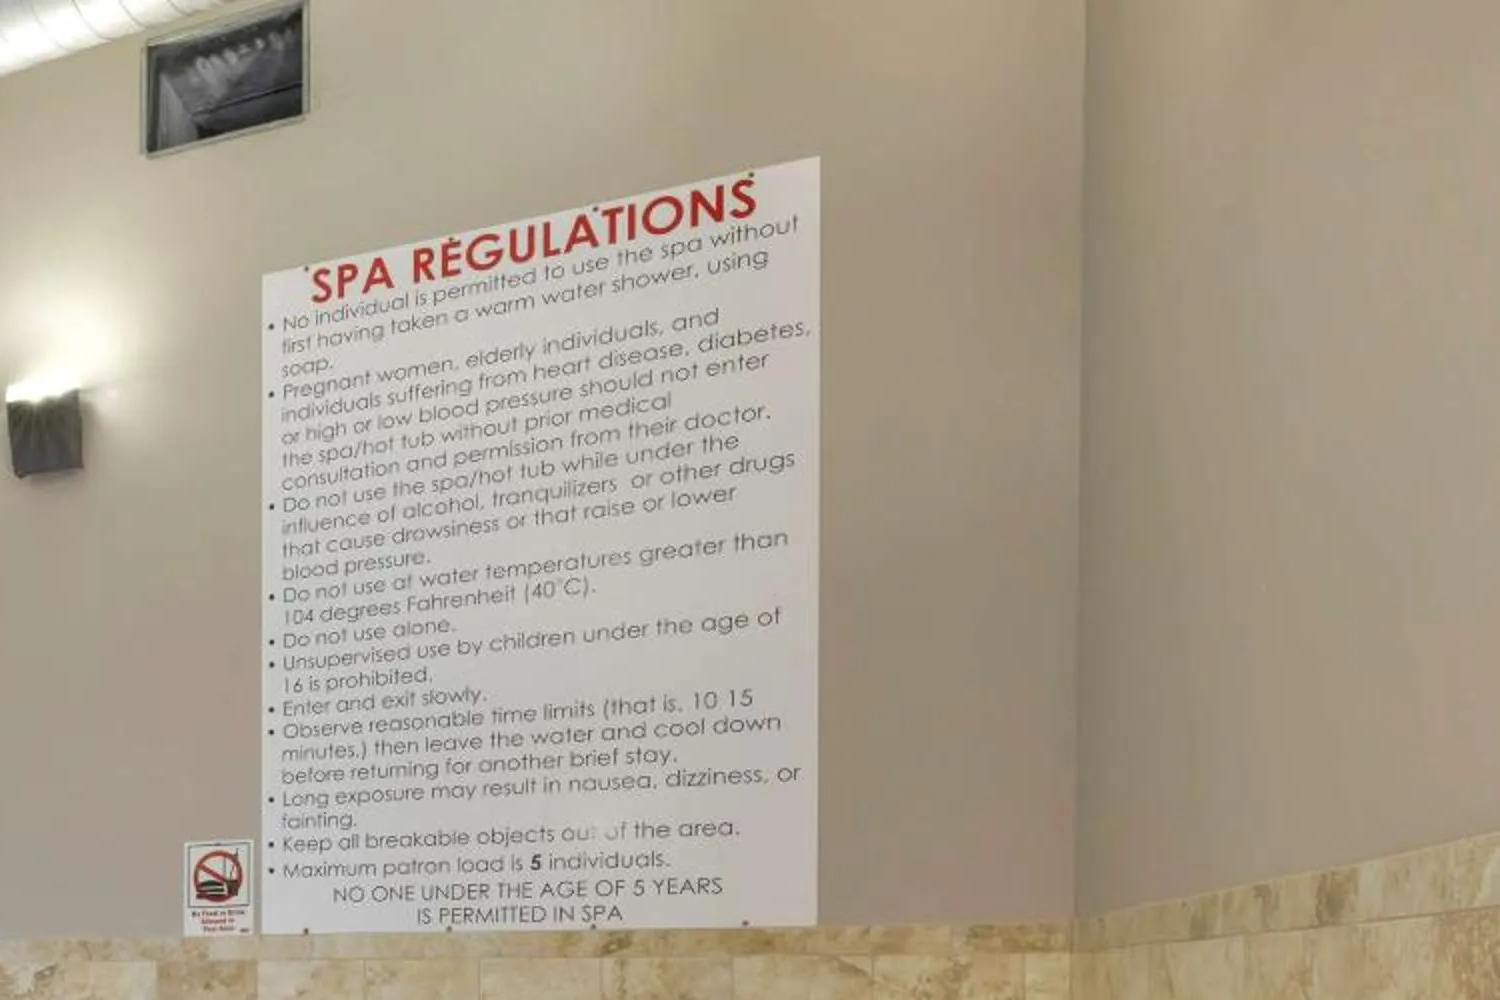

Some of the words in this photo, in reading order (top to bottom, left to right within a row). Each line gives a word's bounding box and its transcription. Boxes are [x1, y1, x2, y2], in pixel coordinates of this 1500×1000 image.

[310, 257, 395, 304] SPA
[412, 179, 757, 285] REGULATIONS
[282, 314, 311, 332] No
[313, 291, 409, 326] individual
[415, 289, 429, 307] is
[432, 267, 537, 307] permitted
[544, 263, 565, 282] to
[571, 256, 610, 276] use
[616, 246, 653, 267] the
[659, 237, 703, 261] spa
[708, 214, 798, 249] without
[316, 324, 385, 348] having
[390, 311, 448, 335] taken
[453, 308, 469, 323] a
[474, 294, 535, 318] warm
[540, 280, 607, 305] water
[707, 250, 769, 275] using
[282, 369, 371, 401] Pregnant
[465, 342, 536, 369] elderly
[671, 306, 719, 332] and
[280, 431, 300, 446] or
[305, 420, 347, 443] high
[352, 418, 373, 435] or
[377, 411, 413, 430] low
[418, 397, 482, 424] blood
[484, 386, 573, 417] pressure
[578, 368, 653, 398] should
[660, 361, 699, 384] not
[704, 353, 770, 377] enter
[281, 391, 382, 423] individuals
[386, 378, 473, 406] suffering
[478, 368, 528, 390] from
[532, 355, 591, 381] heart
[281, 460, 400, 493] consultation
[405, 449, 447, 473] and
[451, 434, 564, 470] permission
[570, 428, 621, 448] from
[628, 415, 678, 440] their
[282, 450, 314, 468] the
[317, 435, 394, 466] spa/hot
[400, 429, 435, 449] tub
[438, 415, 518, 444] without
[524, 409, 573, 436] prior
[578, 391, 671, 423] medical
[281, 511, 371, 535] influence
[376, 503, 396, 524] of
[492, 477, 617, 508] tranquilizers
[630, 472, 653, 489] or
[659, 463, 723, 485] other
[728, 452, 795, 475] drugs
[282, 496, 311, 513] Do
[315, 489, 348, 509] not
[353, 486, 387, 503] use
[392, 480, 425, 497] the
[429, 464, 513, 497] spa/hot
[519, 459, 556, 480] tub
[560, 451, 619, 473] while
[625, 440, 695, 465] under
[700, 433, 739, 455] the
[282, 538, 321, 558] that
[325, 532, 386, 553] cause
[505, 513, 528, 530] or
[532, 503, 577, 526] that
[582, 498, 636, 519] raise
[641, 495, 665, 513] or
[671, 486, 737, 508] lower
[282, 586, 311, 604] Do
[314, 580, 347, 599] not
[353, 578, 387, 596] use
[390, 573, 413, 591] at
[419, 567, 479, 587] water
[484, 550, 632, 581] temperatures
[638, 539, 726, 567] greater
[733, 532, 788, 552] than
[282, 559, 339, 581] blood
[285, 608, 315, 625] 104
[318, 600, 401, 623] degrees
[406, 583, 516, 613] Fahrenheit
[282, 632, 311, 649] Do
[314, 627, 347, 646] not
[353, 624, 387, 642] use
[282, 642, 411, 672] Unsupervised
[416, 643, 451, 659] use
[456, 639, 483, 657] by
[488, 631, 575, 652] children
[582, 622, 650, 643] under
[655, 618, 693, 636] the
[700, 613, 749, 636] age
[756, 606, 781, 627] of
[282, 698, 332, 717] Enter
[335, 693, 376, 714] and
[380, 689, 416, 710] exit
[282, 720, 364, 739] Observe
[368, 709, 485, 734] reasonable
[490, 706, 537, 725] time
[543, 699, 595, 721] limits
[603, 695, 656, 721] (that
[729, 687, 753, 708] 15
[284, 677, 304, 694] 16
[307, 675, 321, 693] is
[280, 765, 345, 785] before
[444, 756, 473, 775] for
[477, 752, 565, 773] another
[568, 746, 620, 768] brief
[374, 738, 419, 757] then
[424, 735, 483, 753] leave
[489, 730, 525, 750] the
[529, 725, 595, 745] water
[600, 720, 647, 742] and
[652, 716, 706, 738] cool
[710, 715, 781, 735] down
[334, 787, 425, 810] exposure
[430, 784, 477, 801] may
[482, 777, 537, 797] result
[543, 775, 561, 793] in
[776, 767, 802, 783] or
[282, 835, 333, 856] Keep
[337, 833, 360, 851] all
[475, 825, 556, 849] objects
[633, 820, 671, 839] the
[282, 860, 377, 878] Maximum
[382, 858, 451, 880] patron
[510, 853, 524, 872] is
[529, 852, 543, 871] 5
[333, 885, 366, 904] NO
[370, 884, 415, 903] ONE
[420, 882, 491, 902] UNDER
[496, 880, 533, 900] THE
[538, 879, 588, 899] AGE
[593, 878, 626, 898] OF
[632, 877, 645, 897] 5
[649, 876, 723, 896] YEARS
[416, 906, 432, 925] IS
[438, 904, 547, 925] PERMITTED
[552, 905, 575, 923] IN
[580, 902, 623, 923] SPA
